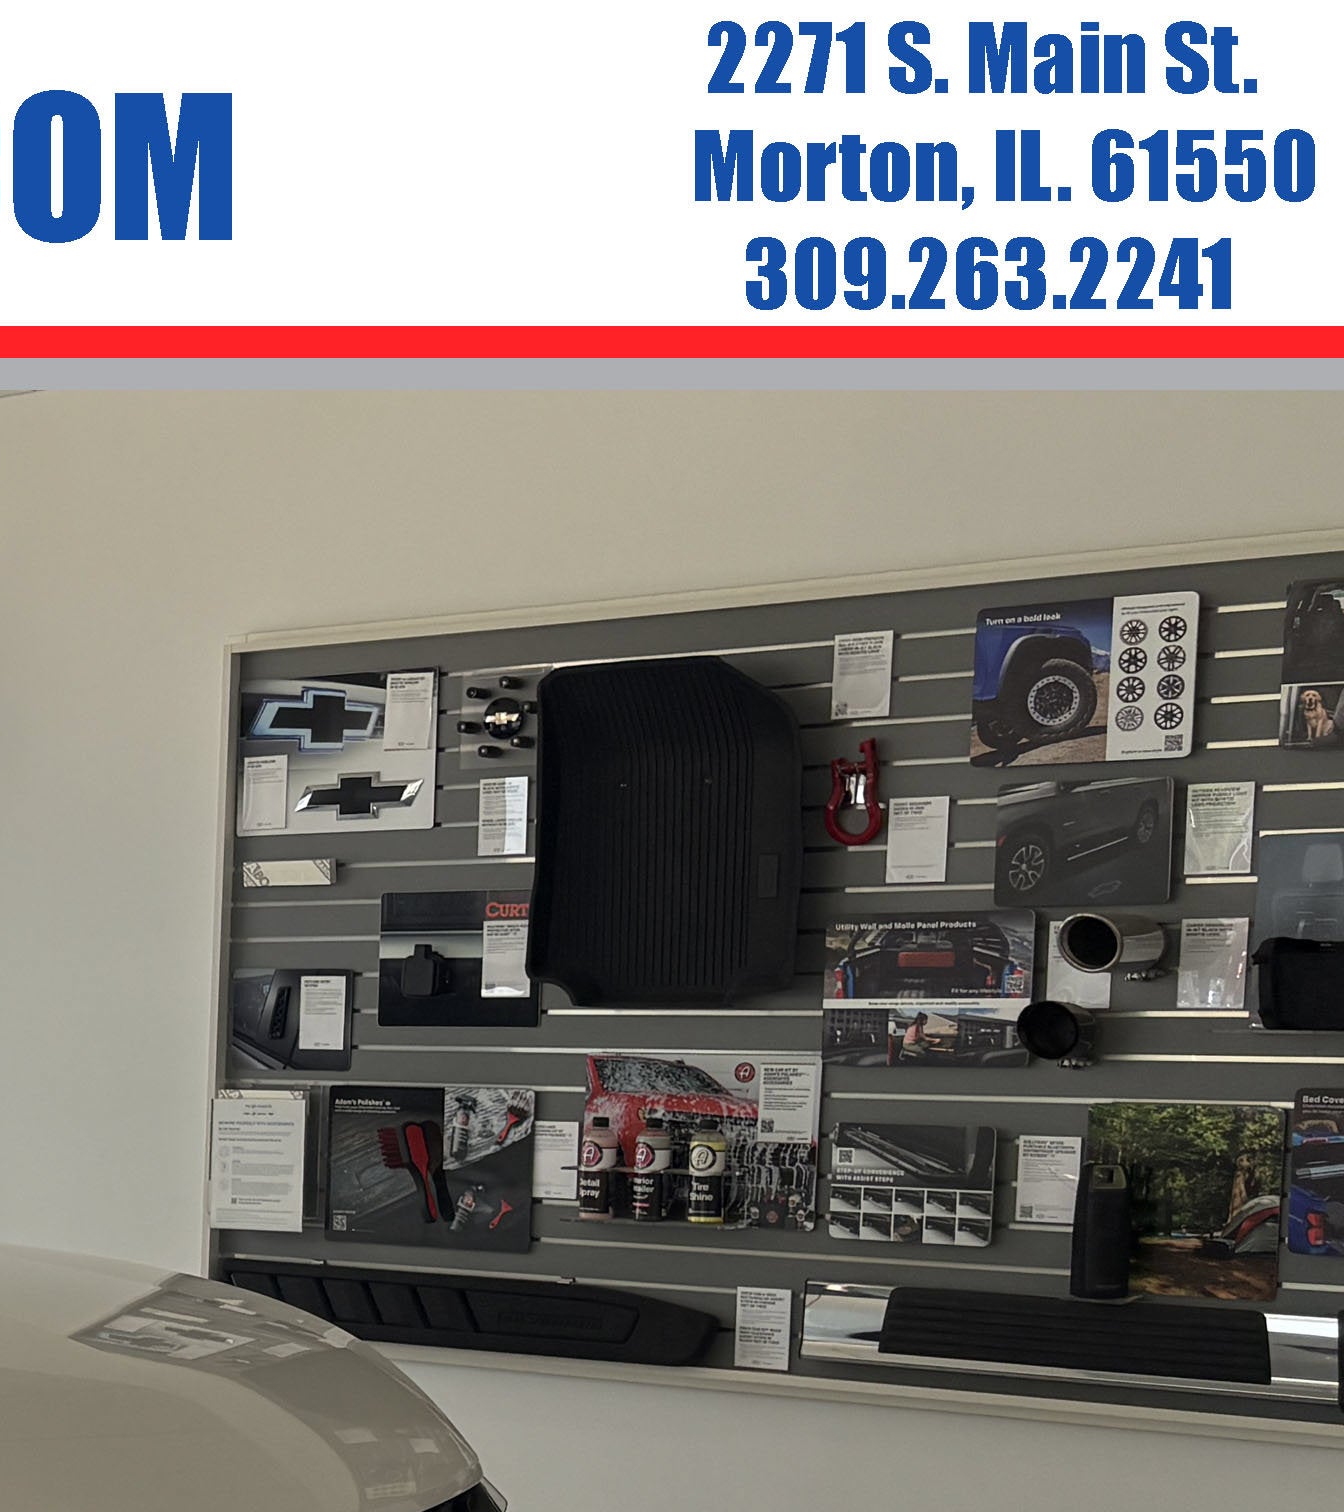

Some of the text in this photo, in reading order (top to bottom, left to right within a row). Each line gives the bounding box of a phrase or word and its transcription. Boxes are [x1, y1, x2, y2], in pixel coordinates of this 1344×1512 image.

[986, 618, 1004, 626] Turn
[1023, 613, 1042, 623] bold
[835, 923, 859, 932] Utility
[860, 922, 877, 931] Wall
[878, 922, 893, 930] and
[916, 921, 939, 930] Panel
[940, 920, 977, 929] Products
[1302, 1095, 1321, 1104] Bed
[692, 1181, 710, 1192] Tire
[689, 1192, 714, 1202] Shine
